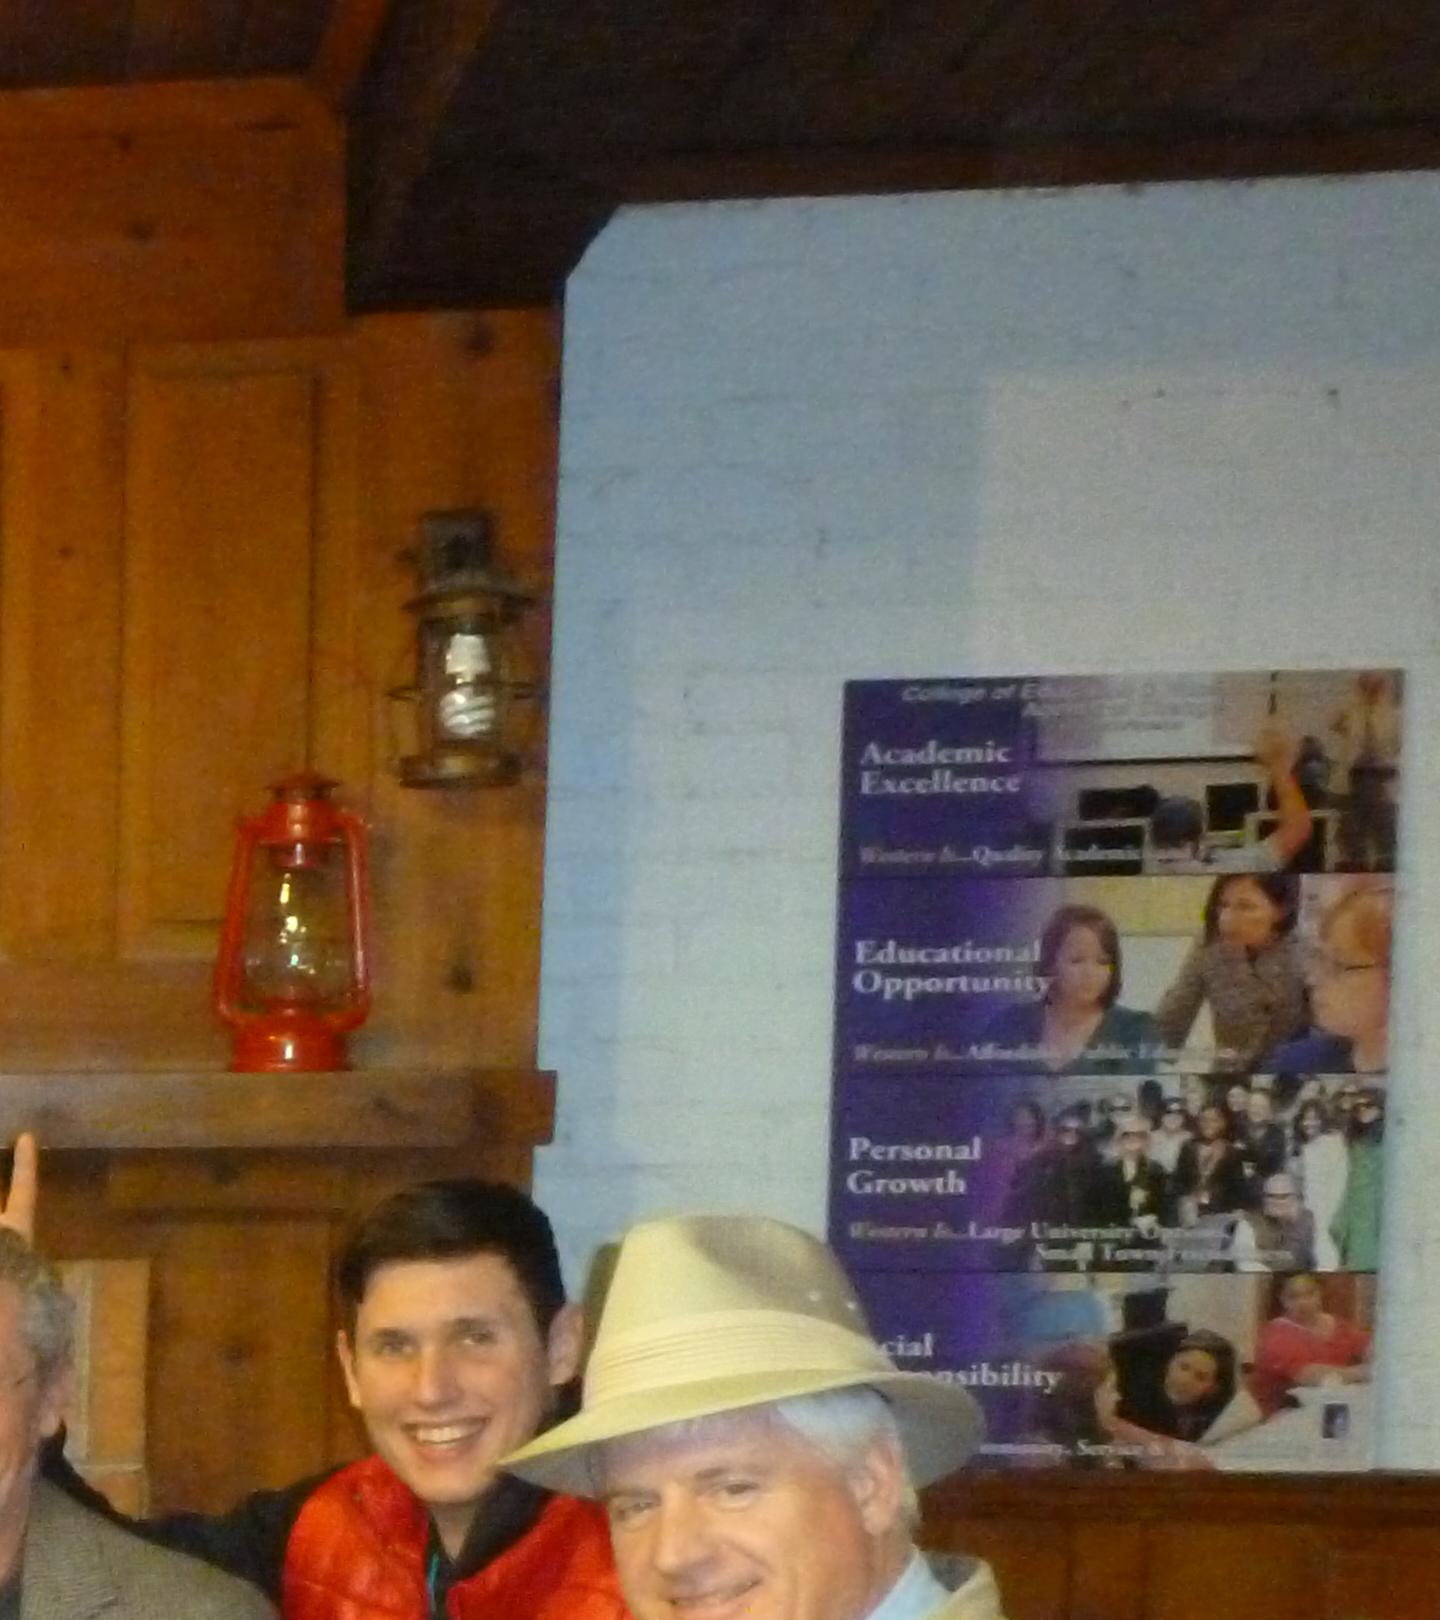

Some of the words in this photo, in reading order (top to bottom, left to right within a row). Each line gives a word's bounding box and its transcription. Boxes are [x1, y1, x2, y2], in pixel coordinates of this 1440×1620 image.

[859, 740, 1010, 765] Academic
[859, 768, 1021, 794] Excellence
[855, 939, 1041, 964] Educational
[853, 968, 1053, 1001] Opportunity
[848, 1135, 981, 1161] Personal
[846, 1169, 966, 1195] Growth
[881, 1332, 934, 1357] cial
